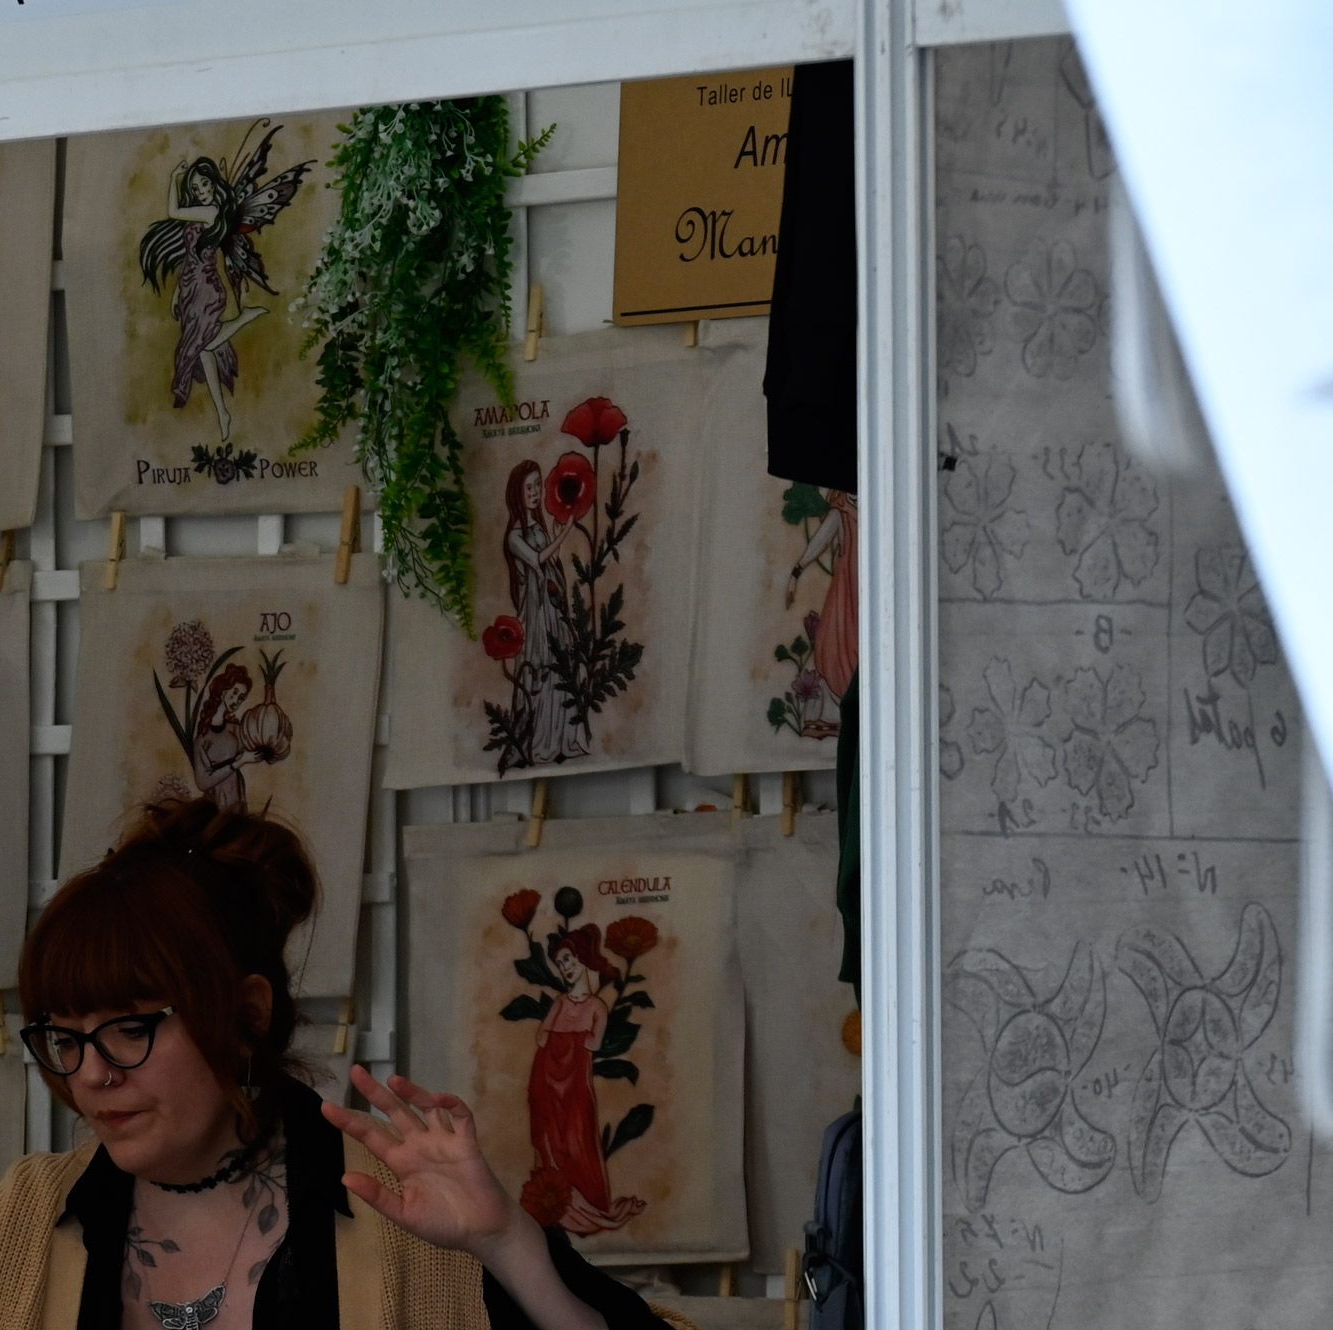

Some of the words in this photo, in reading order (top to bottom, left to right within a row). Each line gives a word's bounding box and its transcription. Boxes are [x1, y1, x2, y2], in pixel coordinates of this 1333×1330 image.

[697, 82, 746, 106] Taller
[753, 80, 773, 101] de
[260, 612, 292, 634] AJO
[598, 876, 672, 896] CALÉNDULA
